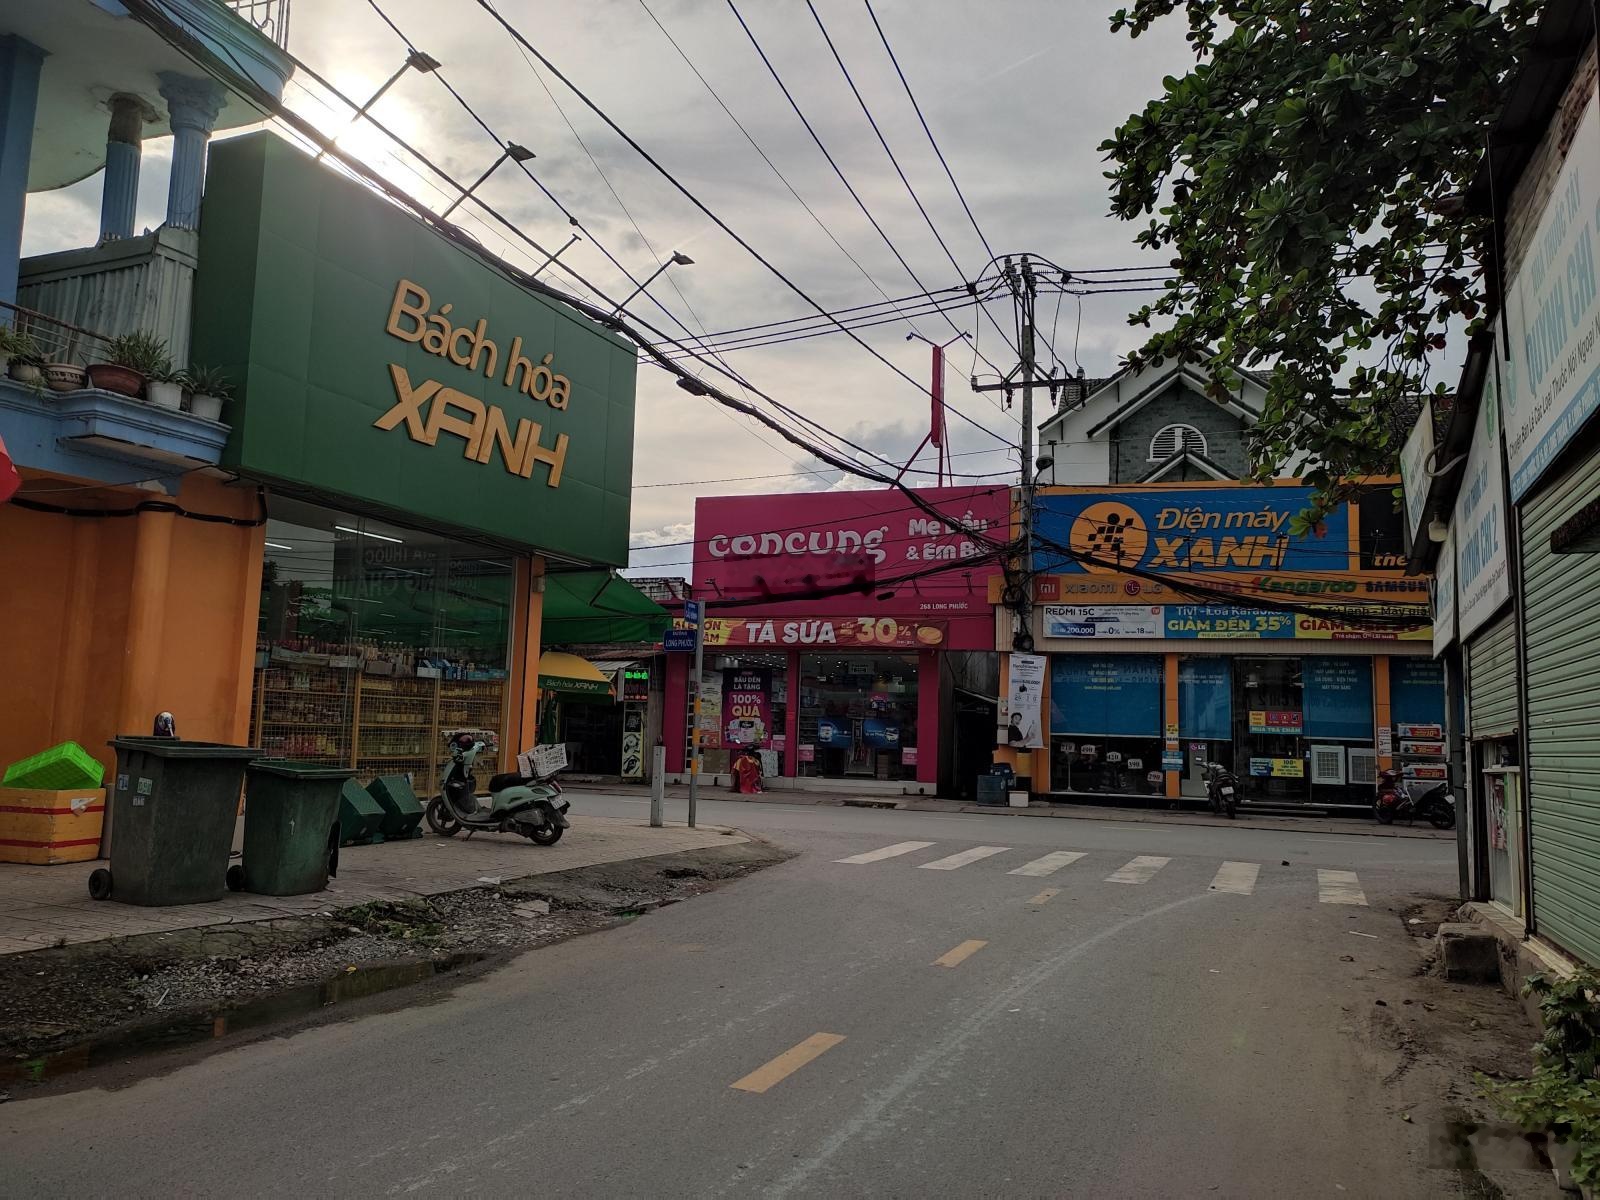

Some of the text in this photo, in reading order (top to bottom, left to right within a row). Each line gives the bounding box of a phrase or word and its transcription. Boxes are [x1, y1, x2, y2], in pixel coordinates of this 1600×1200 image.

[1526, 275, 1568, 400] QUỲNH
[1567, 221, 1597, 328] CHI
[386, 278, 571, 411] Bách hóa
[1552, 367, 1568, 400] Thuốc
[1567, 351, 1578, 378] Nội
[1577, 321, 1596, 364] Ngoại
[372, 363, 570, 488] XANH
[908, 518, 941, 542] Mẹ
[1155, 504, 1290, 534] Điện máy
[1491, 503, 1499, 553] 2
[906, 546, 920, 561] &
[923, 542, 957, 561] Em
[1146, 536, 1290, 568] XANH
[1366, 580, 1427, 593] SAMSUN
[932, 602, 948, 610] LONG
[1045, 607, 1076, 616] REDMI
[1078, 608, 1095, 616] 15C
[1255, 616, 1292, 631] 35%
[665, 639, 678, 648] LONG
[732, 694, 762, 704] 100%
